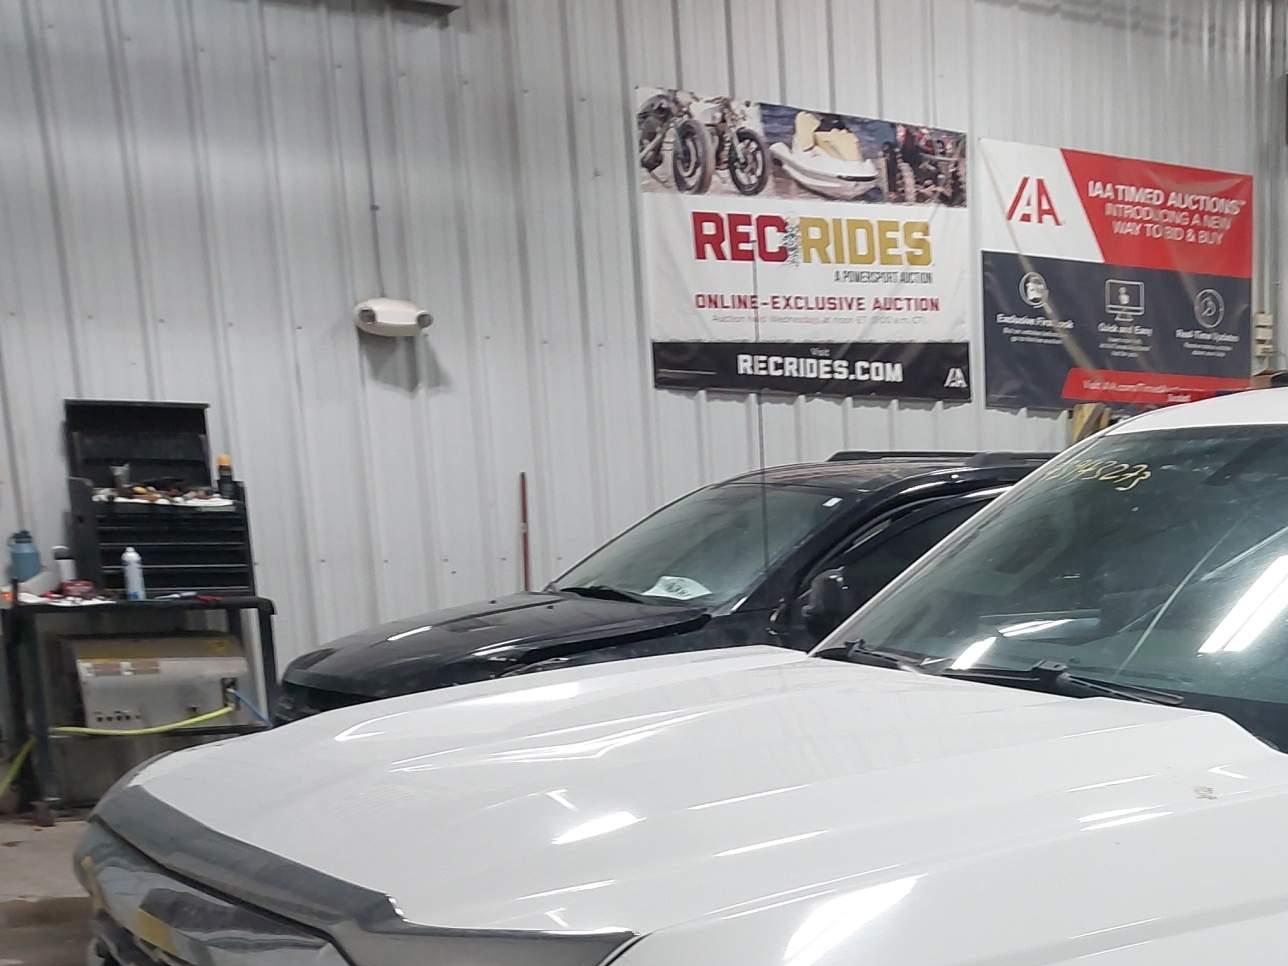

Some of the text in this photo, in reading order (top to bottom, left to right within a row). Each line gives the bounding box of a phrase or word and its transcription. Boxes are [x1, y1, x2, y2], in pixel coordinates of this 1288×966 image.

[1088, 181, 1114, 199] IAA
[1115, 185, 1164, 205] TIMED
[1105, 203, 1232, 230] INTRODUCING A NEW
[1112, 220, 1224, 245] WAY TO BID & BUY
[695, 294, 940, 312] ONLINE-EXCLUSIVE AUCTION
[736, 353, 904, 382] RECRIDES.COM
